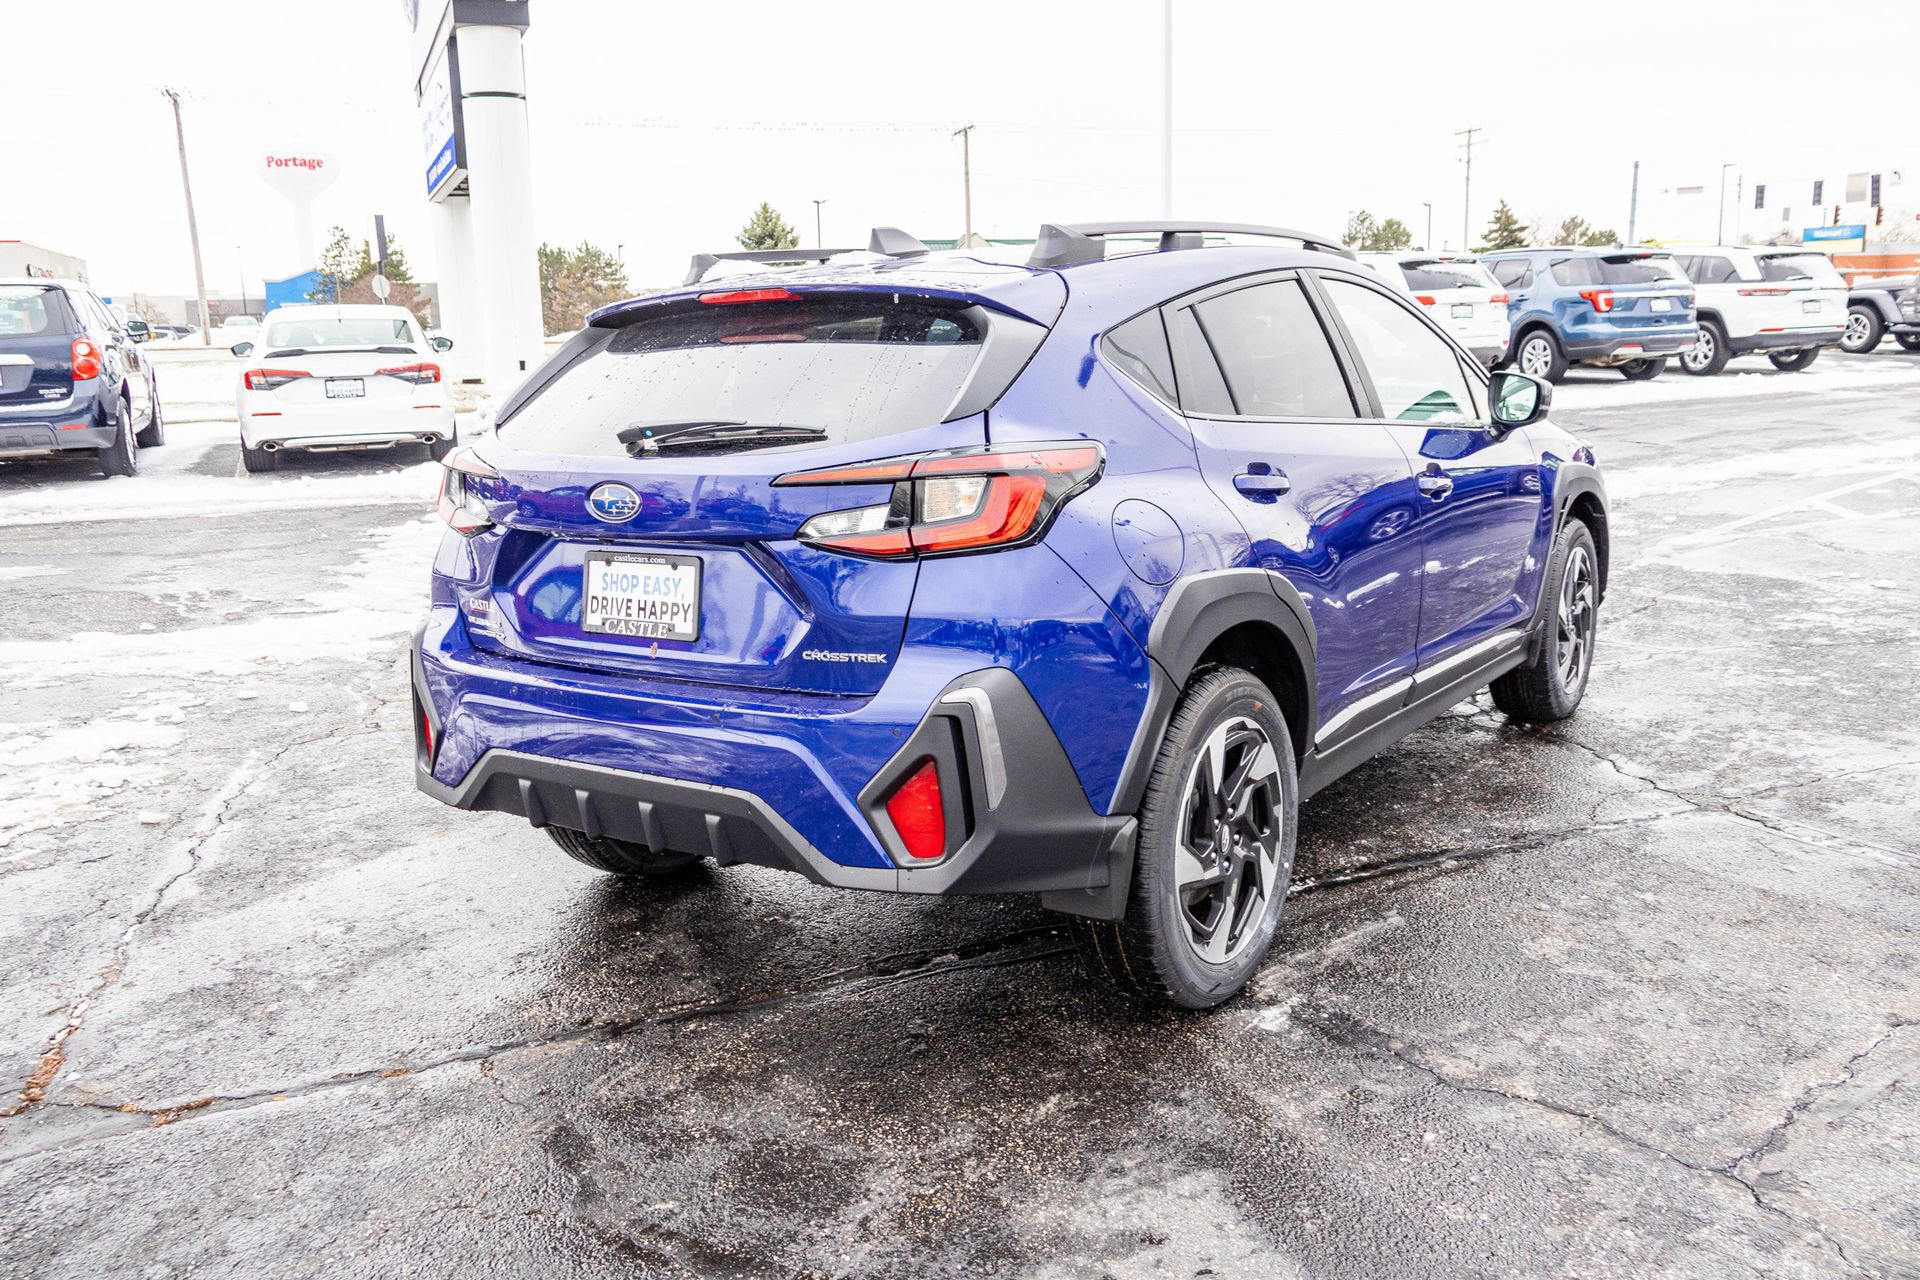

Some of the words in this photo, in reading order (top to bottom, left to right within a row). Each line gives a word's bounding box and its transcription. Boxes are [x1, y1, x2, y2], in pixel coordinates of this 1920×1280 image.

[266, 156, 323, 170] Portage
[614, 554, 666, 564] castlecars.com
[601, 572, 639, 593] SHOP
[643, 575, 684, 601] EASY,
[590, 595, 632, 618] DRIVE
[637, 599, 691, 623] HAPPY
[605, 619, 668, 639] CASTLE
[802, 649, 887, 663] CROSSTREK
